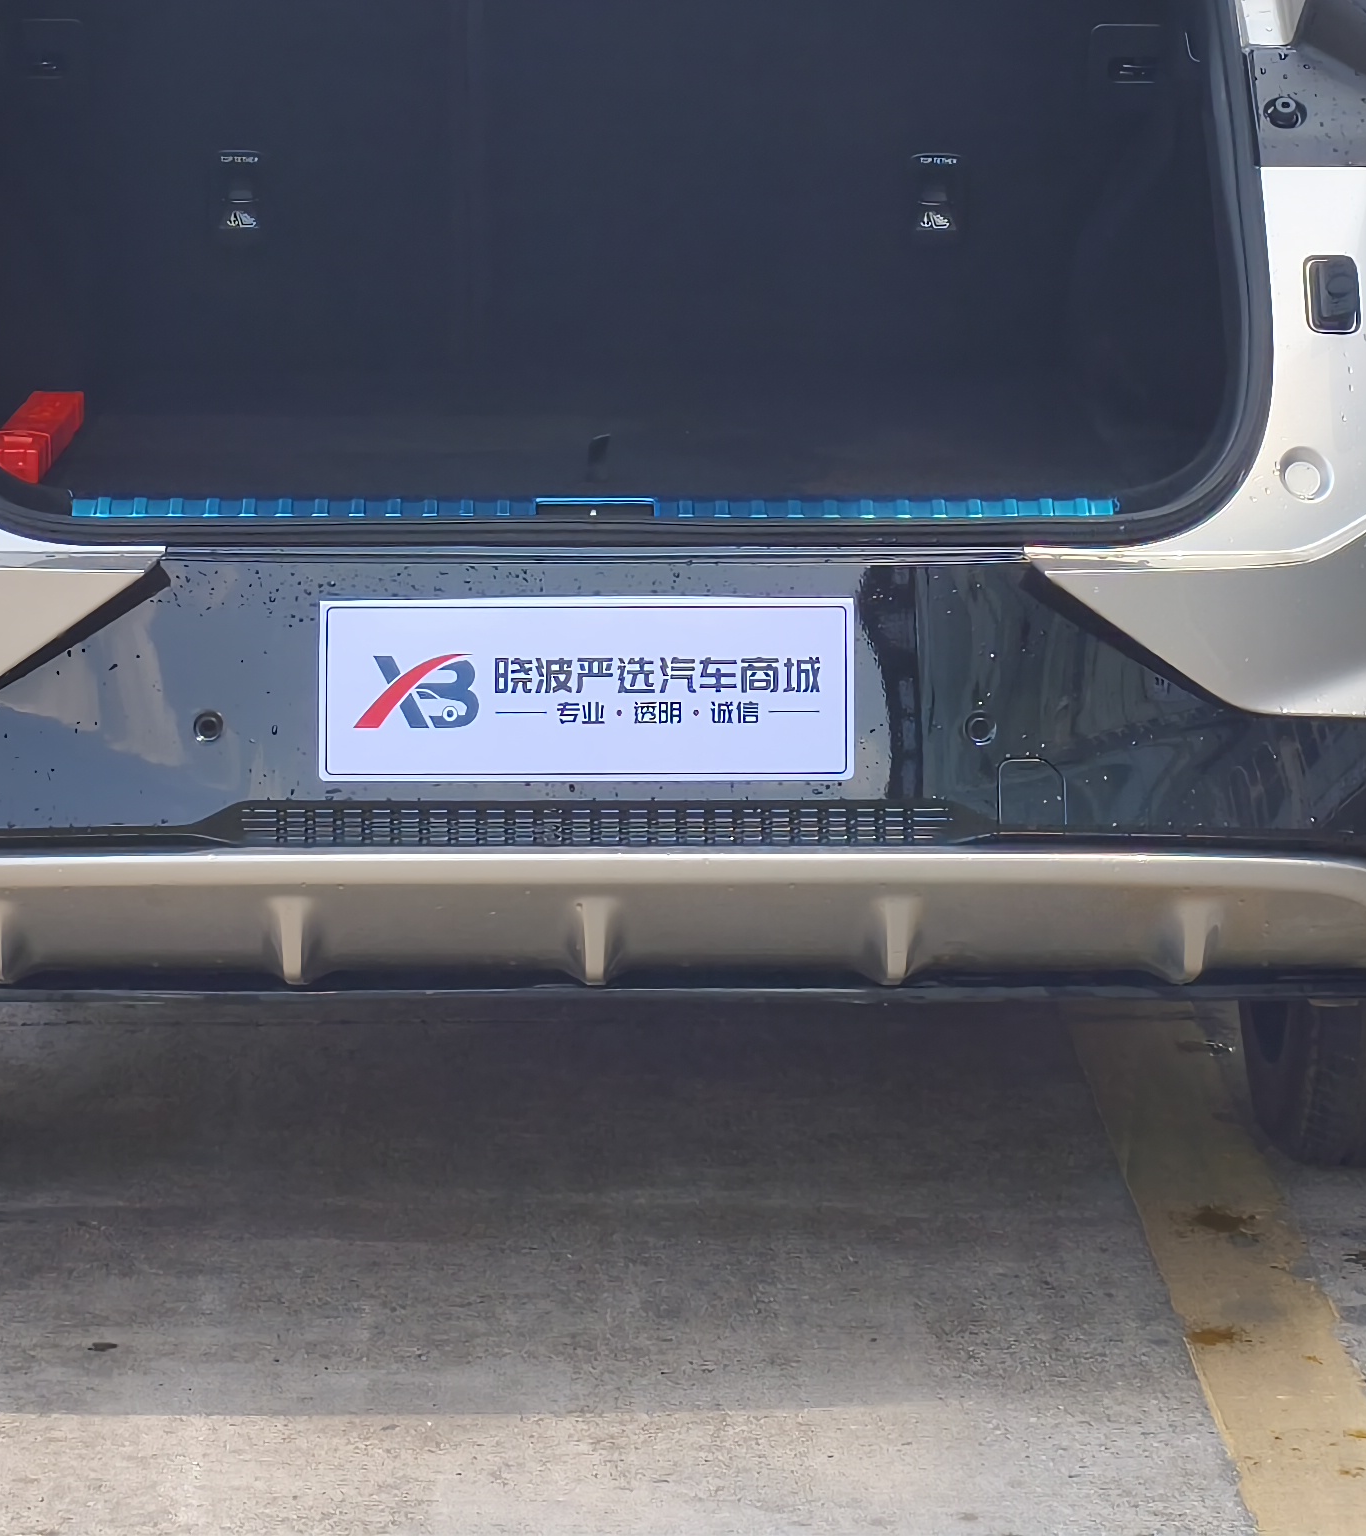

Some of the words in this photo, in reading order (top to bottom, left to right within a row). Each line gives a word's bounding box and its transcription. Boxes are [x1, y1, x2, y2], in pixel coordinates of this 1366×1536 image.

[494, 656, 821, 694] 晓波严选汽车商城
